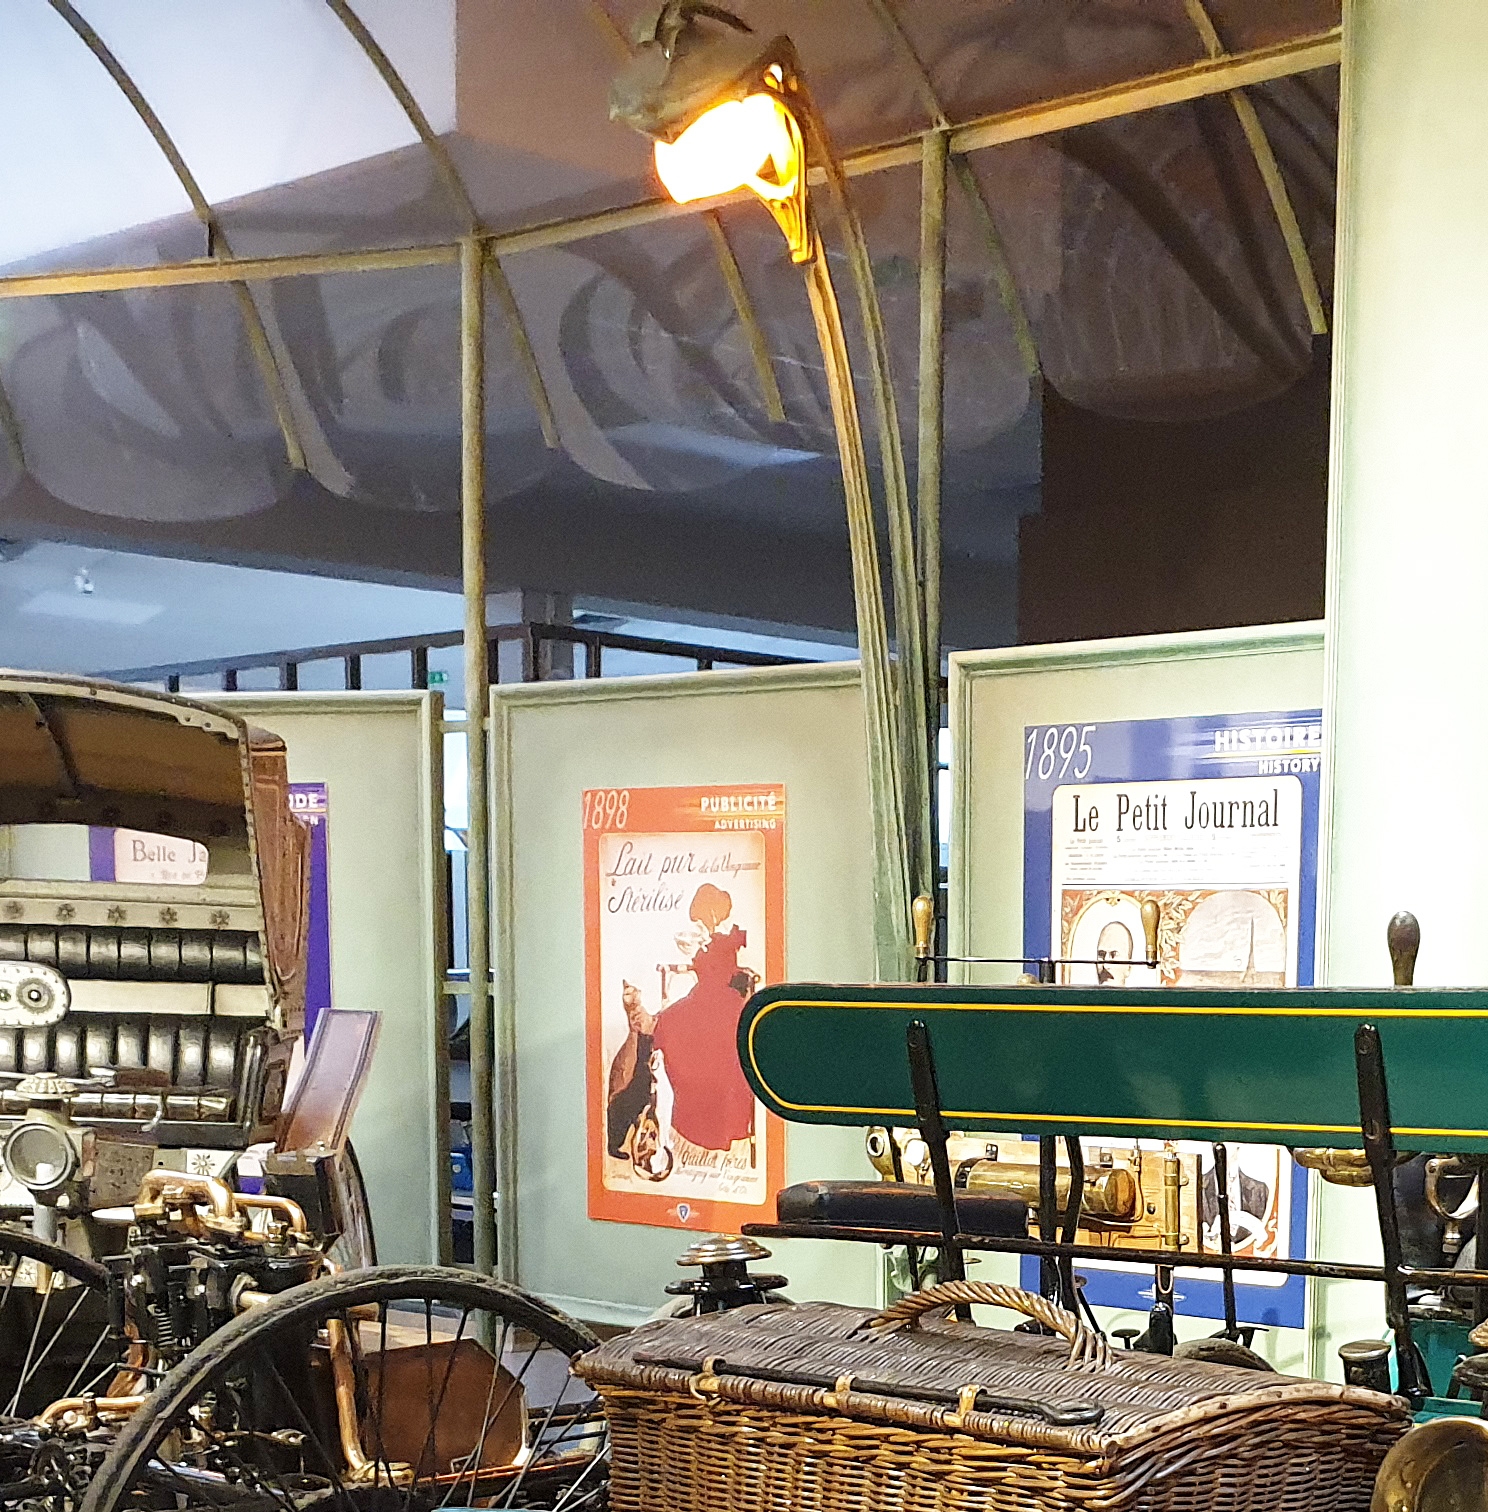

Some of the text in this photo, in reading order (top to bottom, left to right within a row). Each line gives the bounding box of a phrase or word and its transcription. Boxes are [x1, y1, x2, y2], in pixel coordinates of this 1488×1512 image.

[1214, 726, 1322, 752] HISTOIRE
[1025, 726, 1096, 780] 1895
[1258, 758, 1320, 775] HISTORY
[582, 790, 630, 829] 1898
[701, 792, 777, 812] PUBLICITÉ
[1073, 789, 1279, 832] Le Petit Journal
[714, 818, 777, 829] ADVERTISING
[132, 839, 176, 862] Belle
[658, 852, 695, 881] pur
